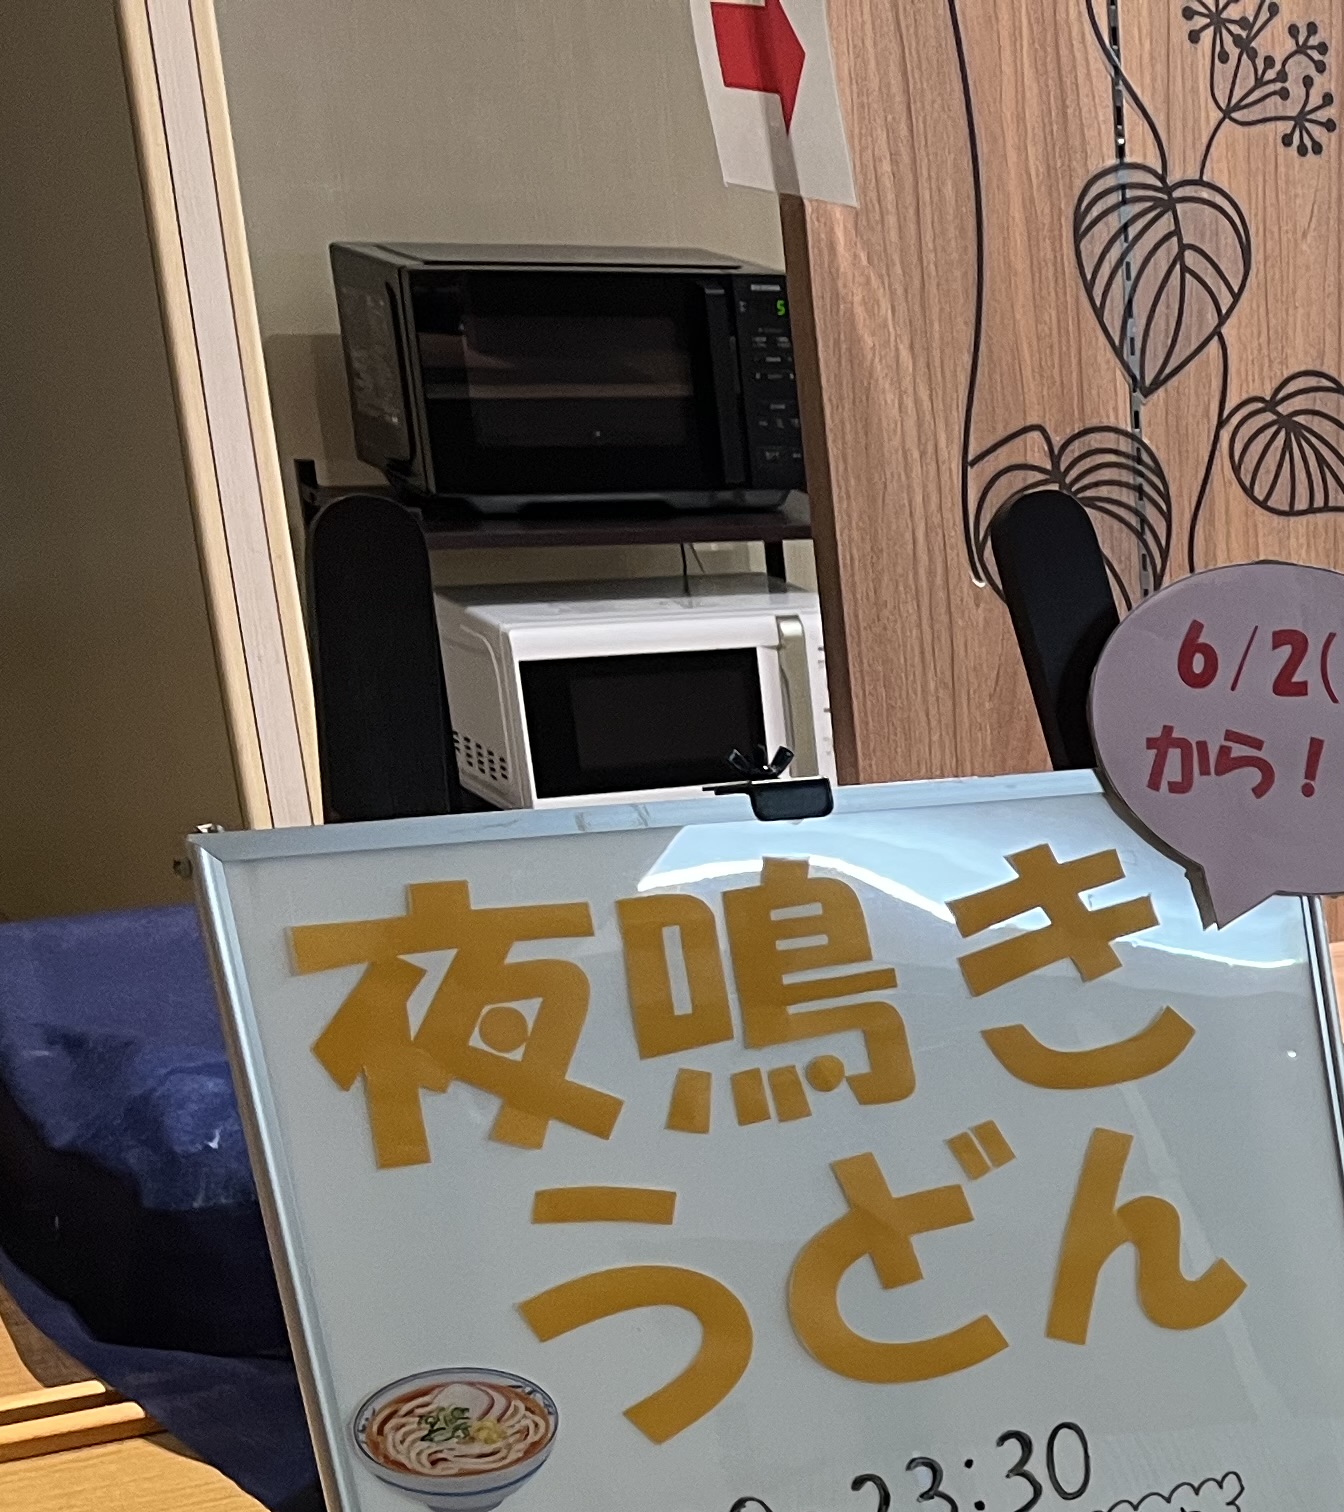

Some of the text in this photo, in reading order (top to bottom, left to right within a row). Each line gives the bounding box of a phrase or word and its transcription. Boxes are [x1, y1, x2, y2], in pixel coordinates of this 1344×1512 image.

[290, 843, 1196, 1169] 夜鳴き
[517, 1119, 1247, 1444] うどん
